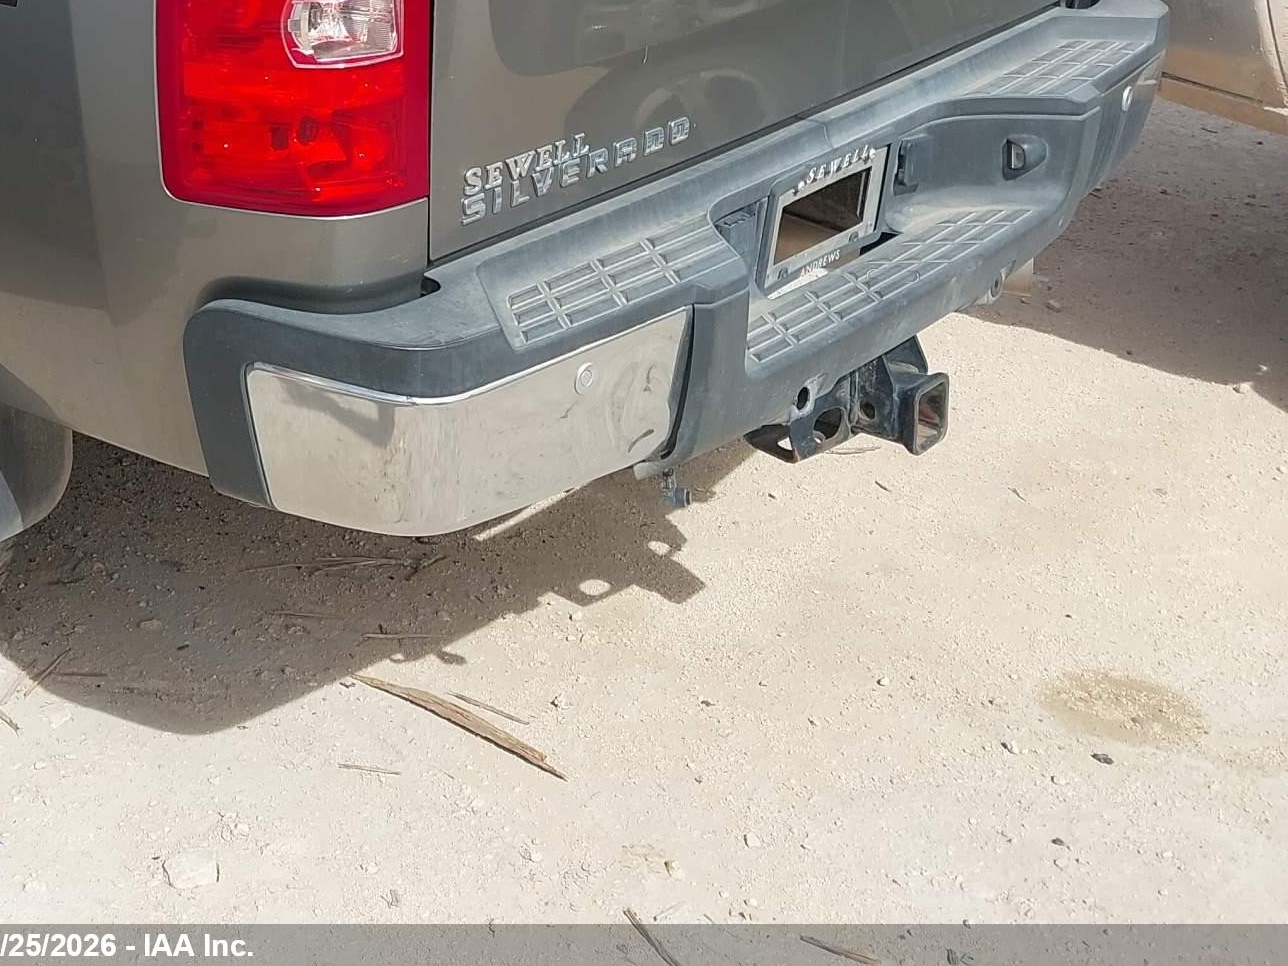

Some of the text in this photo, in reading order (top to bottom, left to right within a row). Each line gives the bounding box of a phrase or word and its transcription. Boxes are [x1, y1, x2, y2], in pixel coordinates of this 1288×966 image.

[461, 117, 691, 226] SILVERADO
[464, 133, 589, 195] SEWELL
[806, 144, 870, 184] SEWELL
[800, 249, 841, 278] ANDREWS
